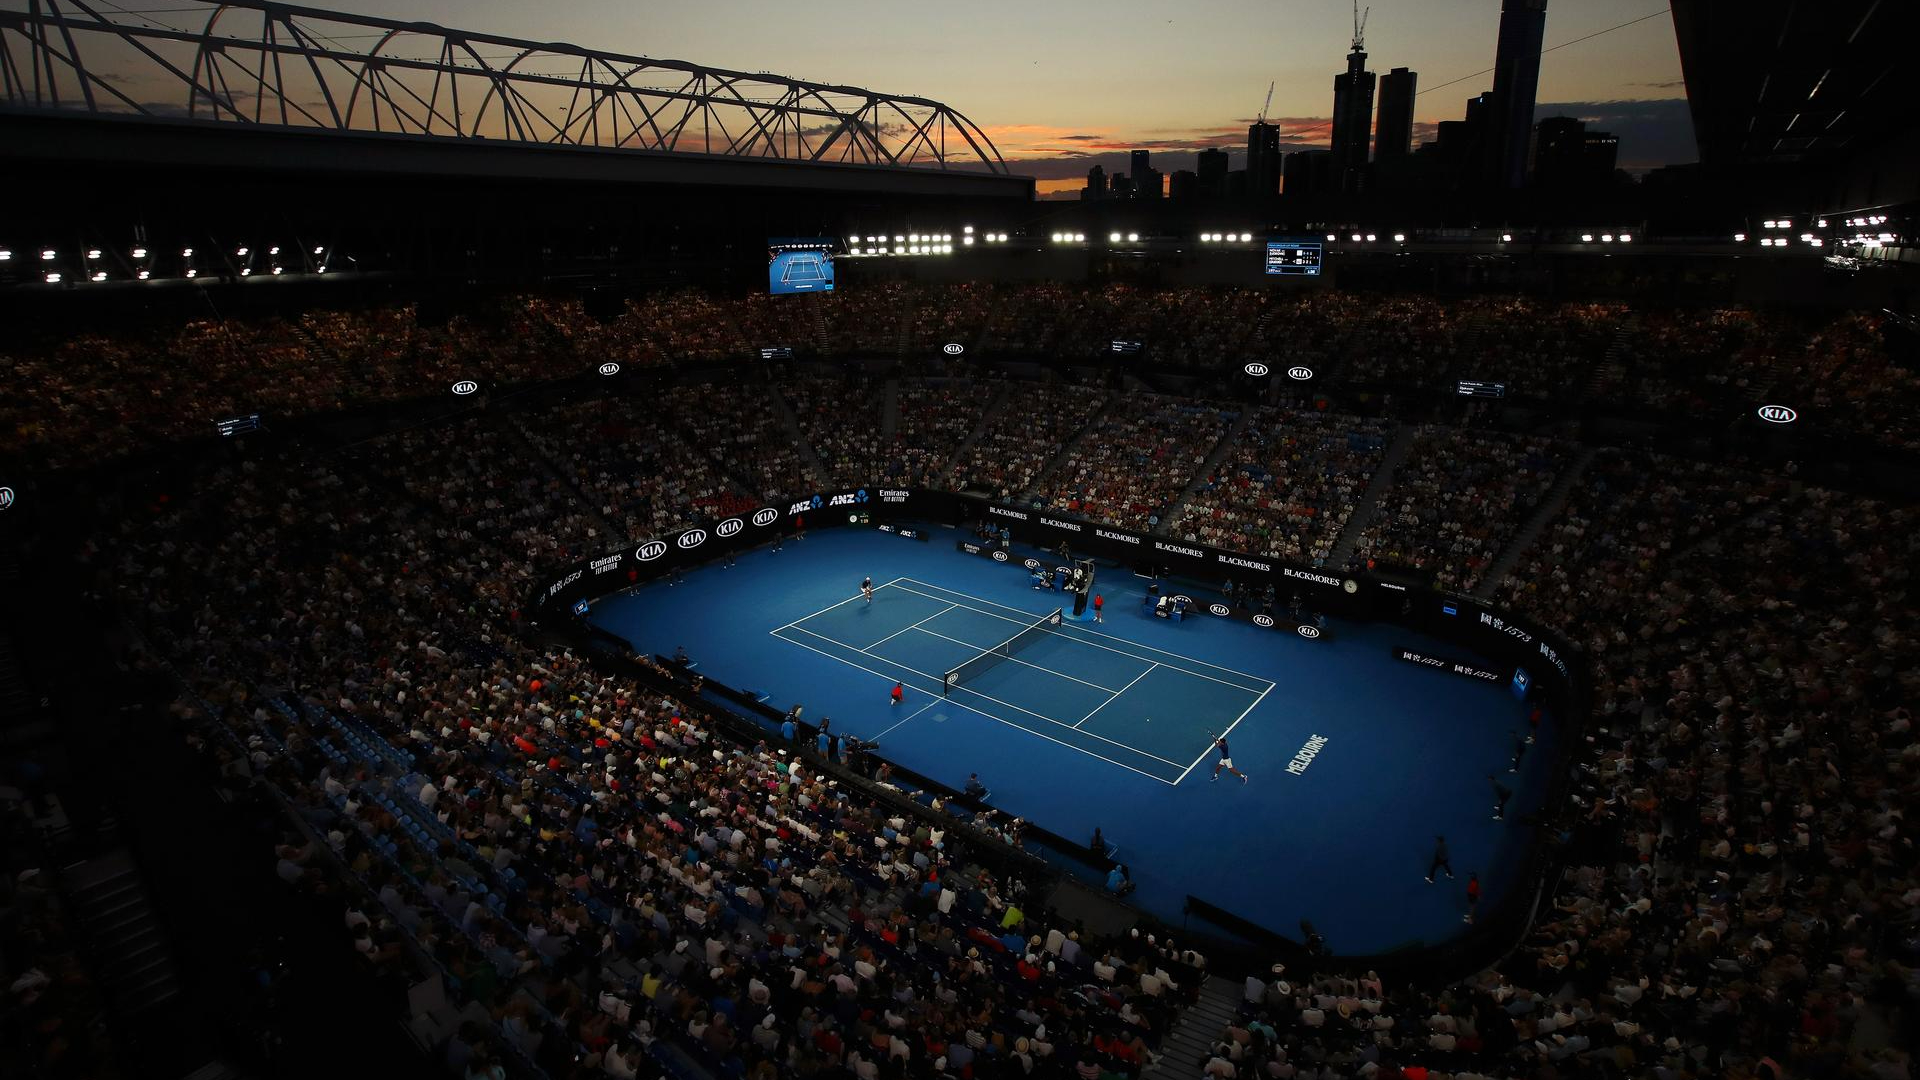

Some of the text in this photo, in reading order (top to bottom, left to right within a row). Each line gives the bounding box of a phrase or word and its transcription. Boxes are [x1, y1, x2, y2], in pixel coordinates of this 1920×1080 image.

[829, 493, 855, 506] ANZ
[879, 489, 910, 497] Emirates
[788, 500, 811, 516] ANZ
[989, 506, 1027, 520] BLACKMORES
[1040, 517, 1081, 531] BLACKMORES
[1096, 529, 1140, 544] BLACKMORES
[1155, 541, 1203, 557] BLACKMORES
[590, 553, 622, 570] Emirates
[1218, 554, 1270, 571] BLACKMORES
[1284, 568, 1340, 586] BLACKMORES
[1504, 625, 1532, 642] 1573
[1284, 734, 1329, 776] MELBOURNE
